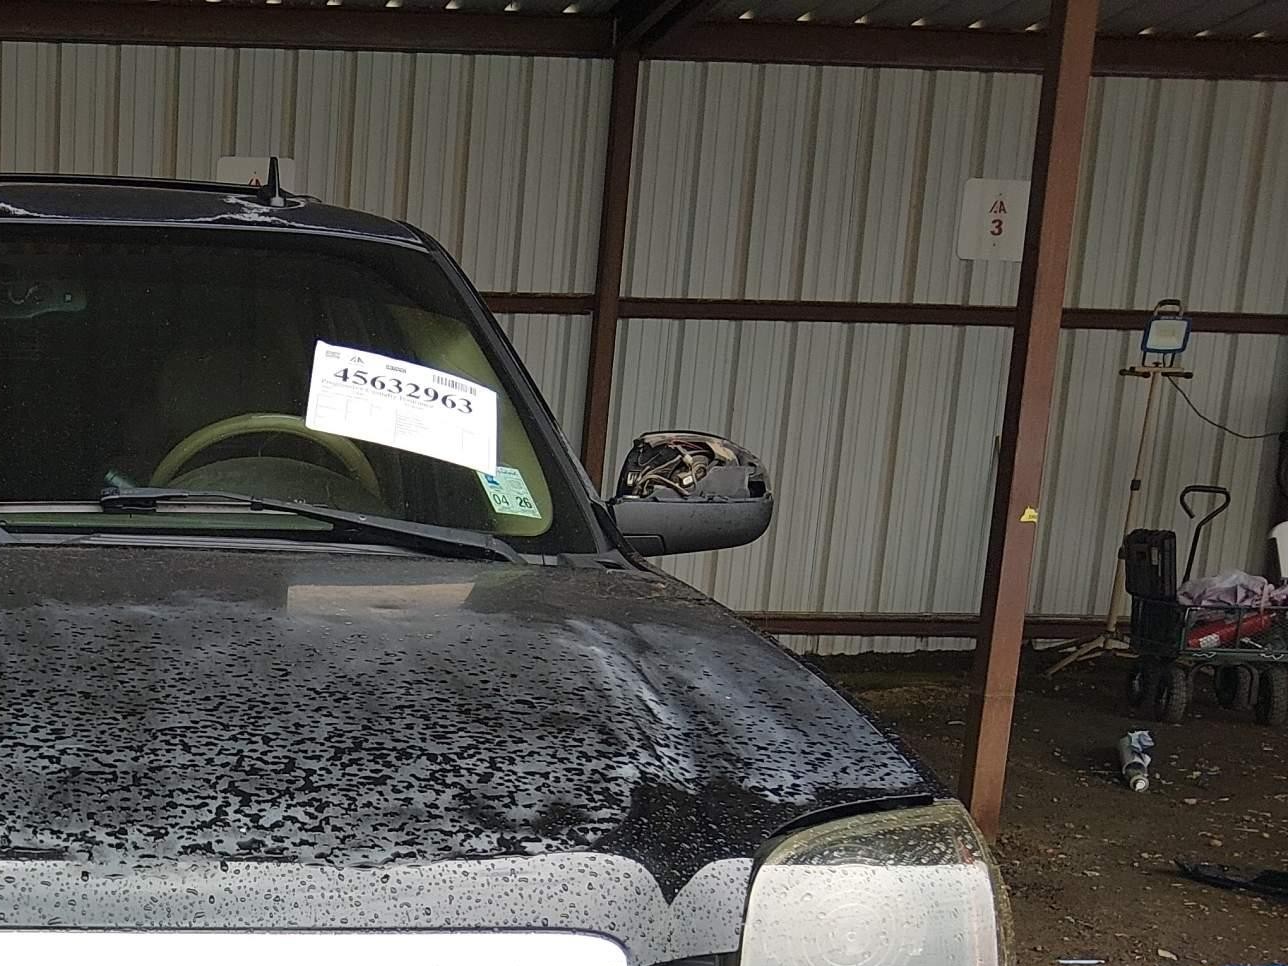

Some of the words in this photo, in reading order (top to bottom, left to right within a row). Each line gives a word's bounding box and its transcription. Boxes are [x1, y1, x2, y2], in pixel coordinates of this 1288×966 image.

[990, 219, 1004, 236] 3
[333, 367, 473, 414] 45632963
[492, 494, 510, 507] 04
[515, 496, 533, 509] 26
